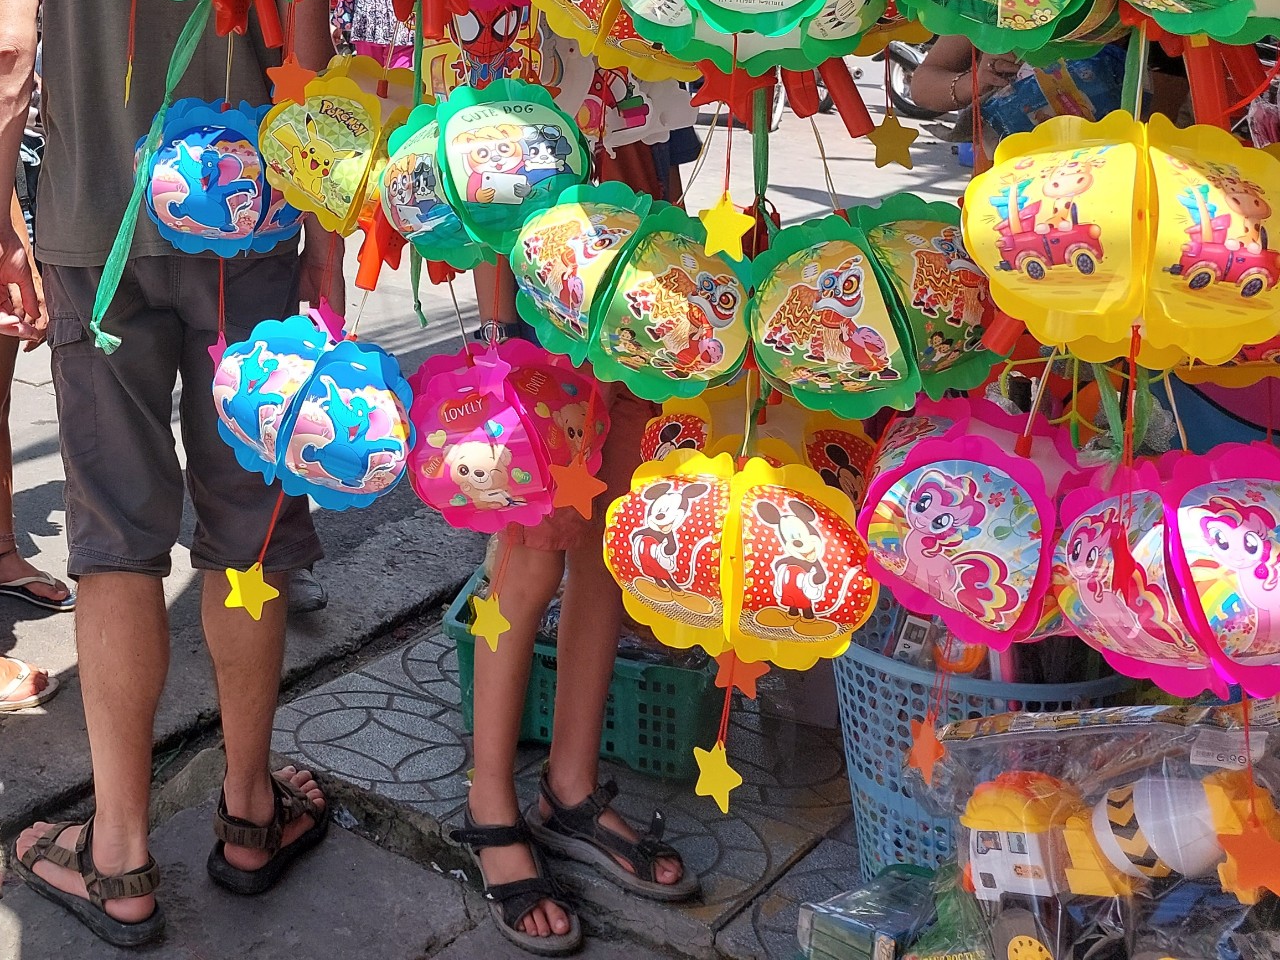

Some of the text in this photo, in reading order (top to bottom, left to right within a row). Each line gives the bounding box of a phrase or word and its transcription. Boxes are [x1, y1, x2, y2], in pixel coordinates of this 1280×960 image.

[461, 104, 534, 123] CUTE DOG
[443, 397, 483, 423] LOVELY
